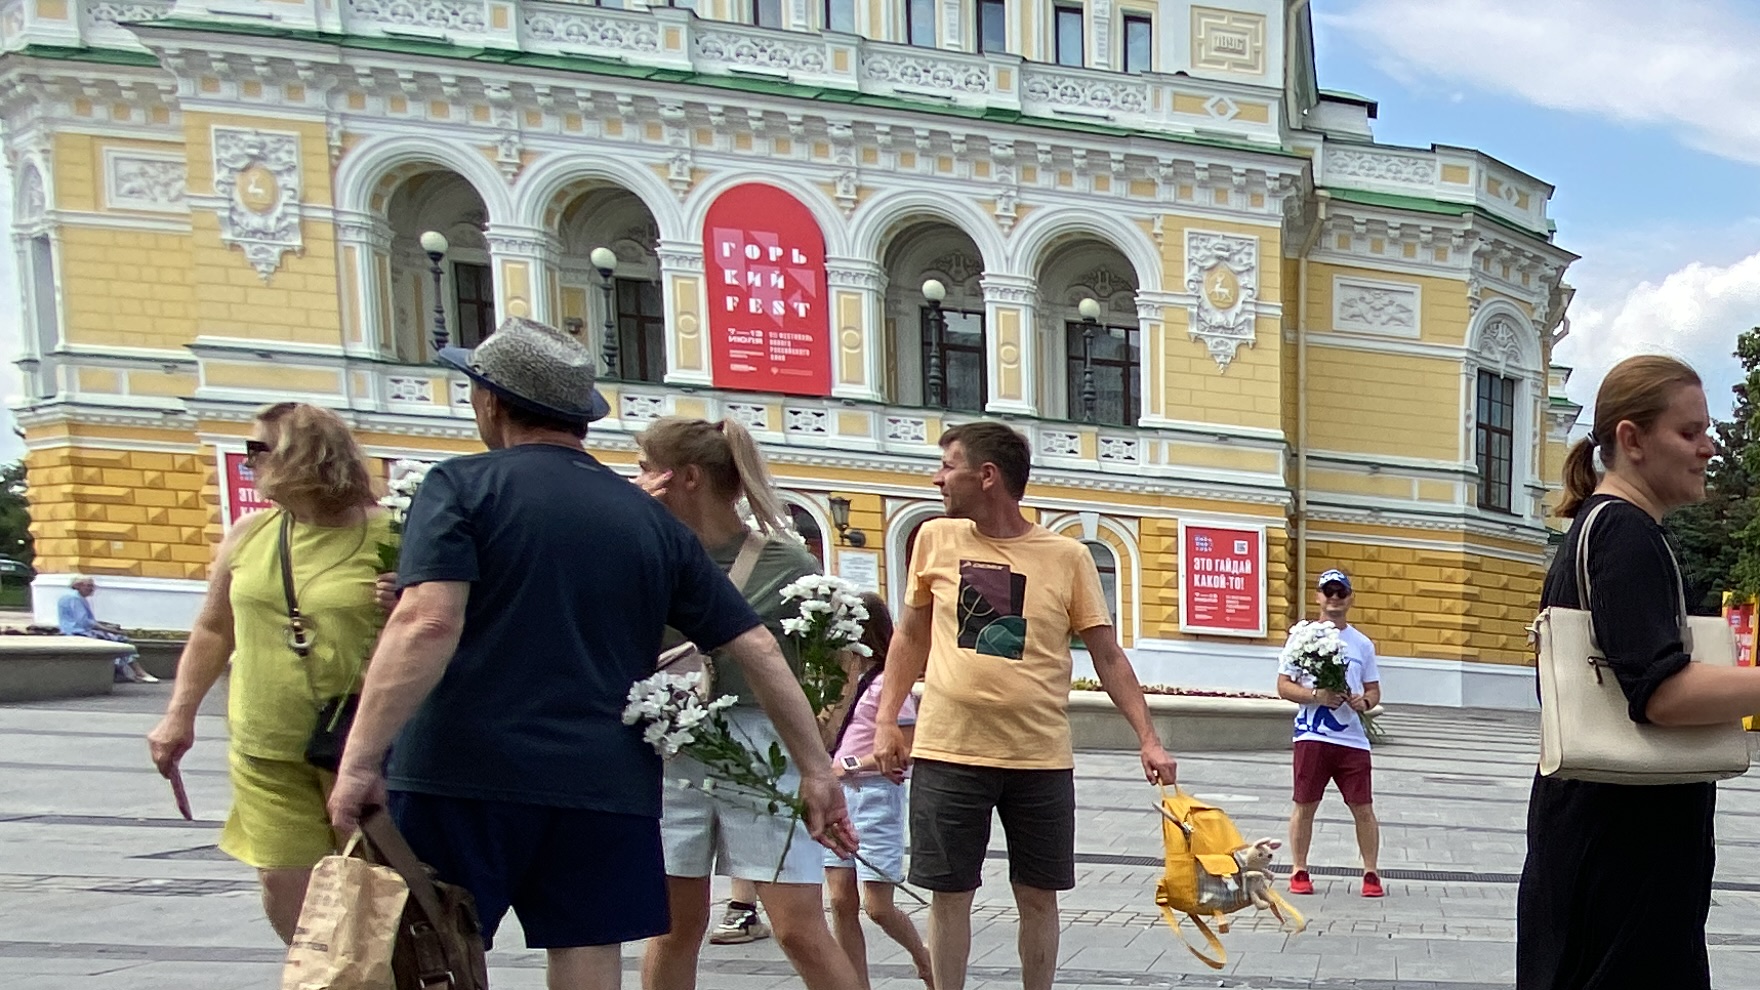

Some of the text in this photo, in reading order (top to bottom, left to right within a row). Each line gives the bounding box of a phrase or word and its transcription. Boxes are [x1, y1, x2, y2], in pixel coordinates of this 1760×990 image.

[722, 241, 807, 264] ГОРЬ
[724, 269, 785, 290] КИЙ
[726, 295, 811, 318] FEST
[1193, 557, 1252, 575] ЭТО ГАЙДАЙ
[1193, 574, 1245, 590] КАКОЙ-ТО!
